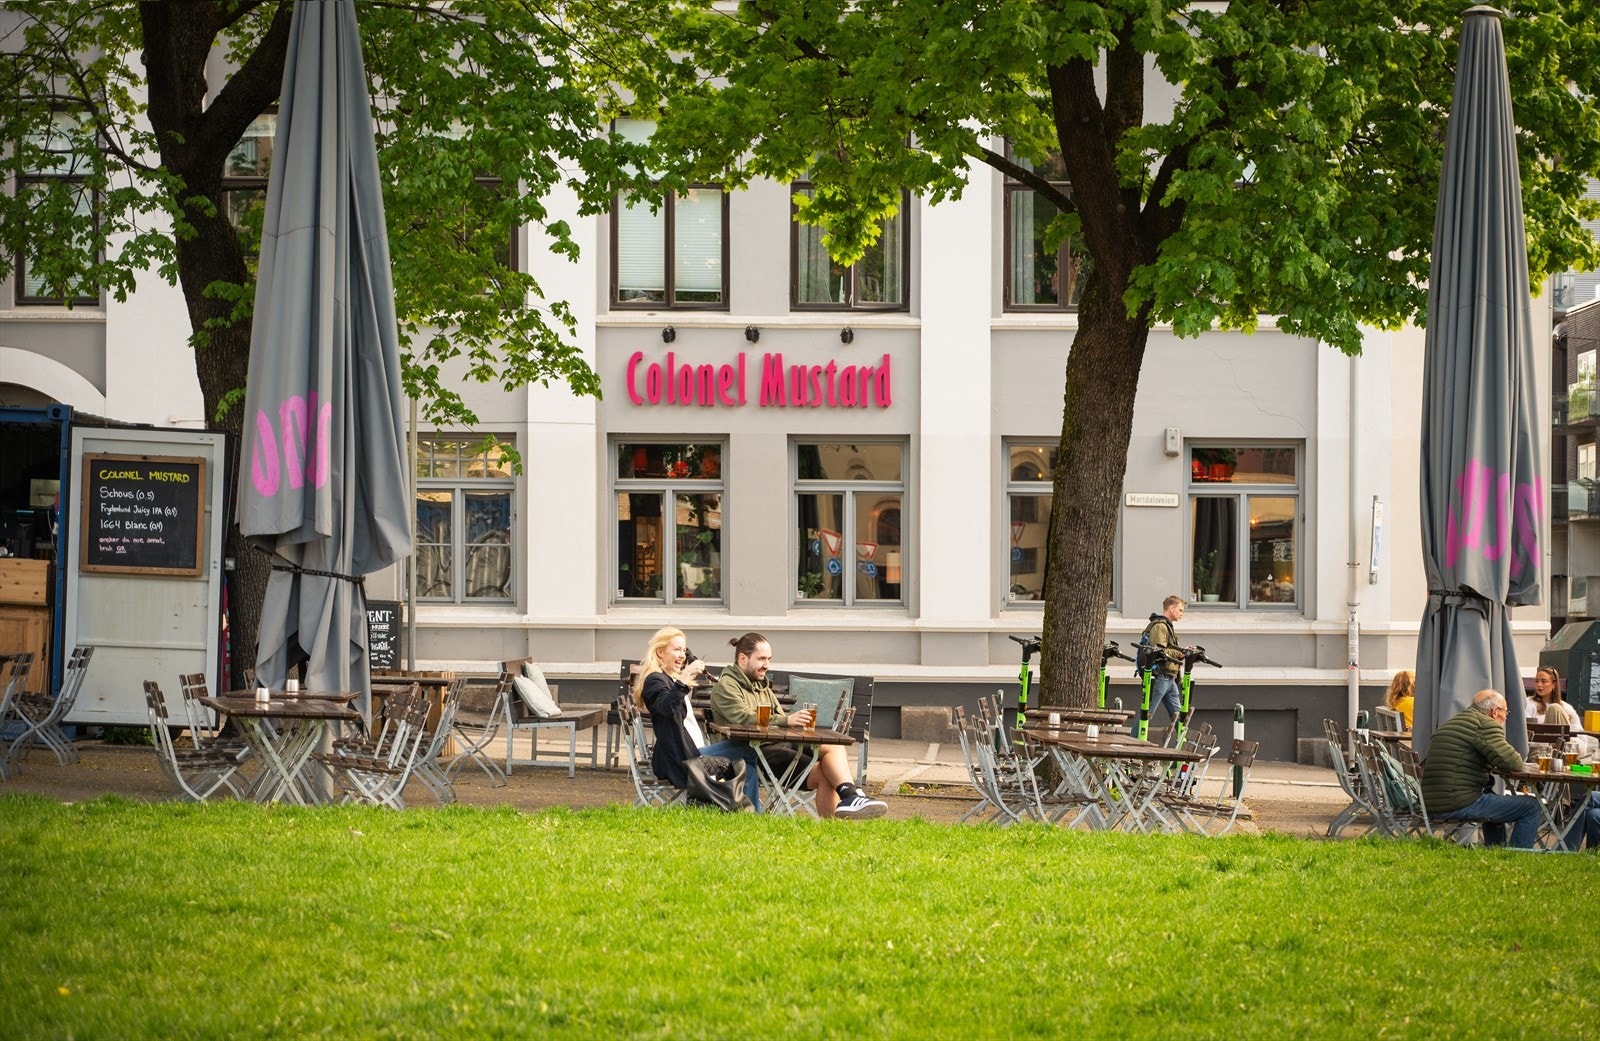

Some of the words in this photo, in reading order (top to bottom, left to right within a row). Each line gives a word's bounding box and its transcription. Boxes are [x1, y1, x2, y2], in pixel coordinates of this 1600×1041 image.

[626, 351, 747, 407] Colonel
[759, 352, 893, 408] Mustard
[99, 469, 144, 480] COLONEL
[149, 471, 190, 483] MUSTARD
[99, 486, 134, 499] Schous
[1130, 495, 1176, 504] Maridalsveien
[133, 505, 151, 517] Juicy
[152, 506, 163, 515] IPA
[100, 519, 121, 529] 1664
[125, 520, 148, 530] Blanc
